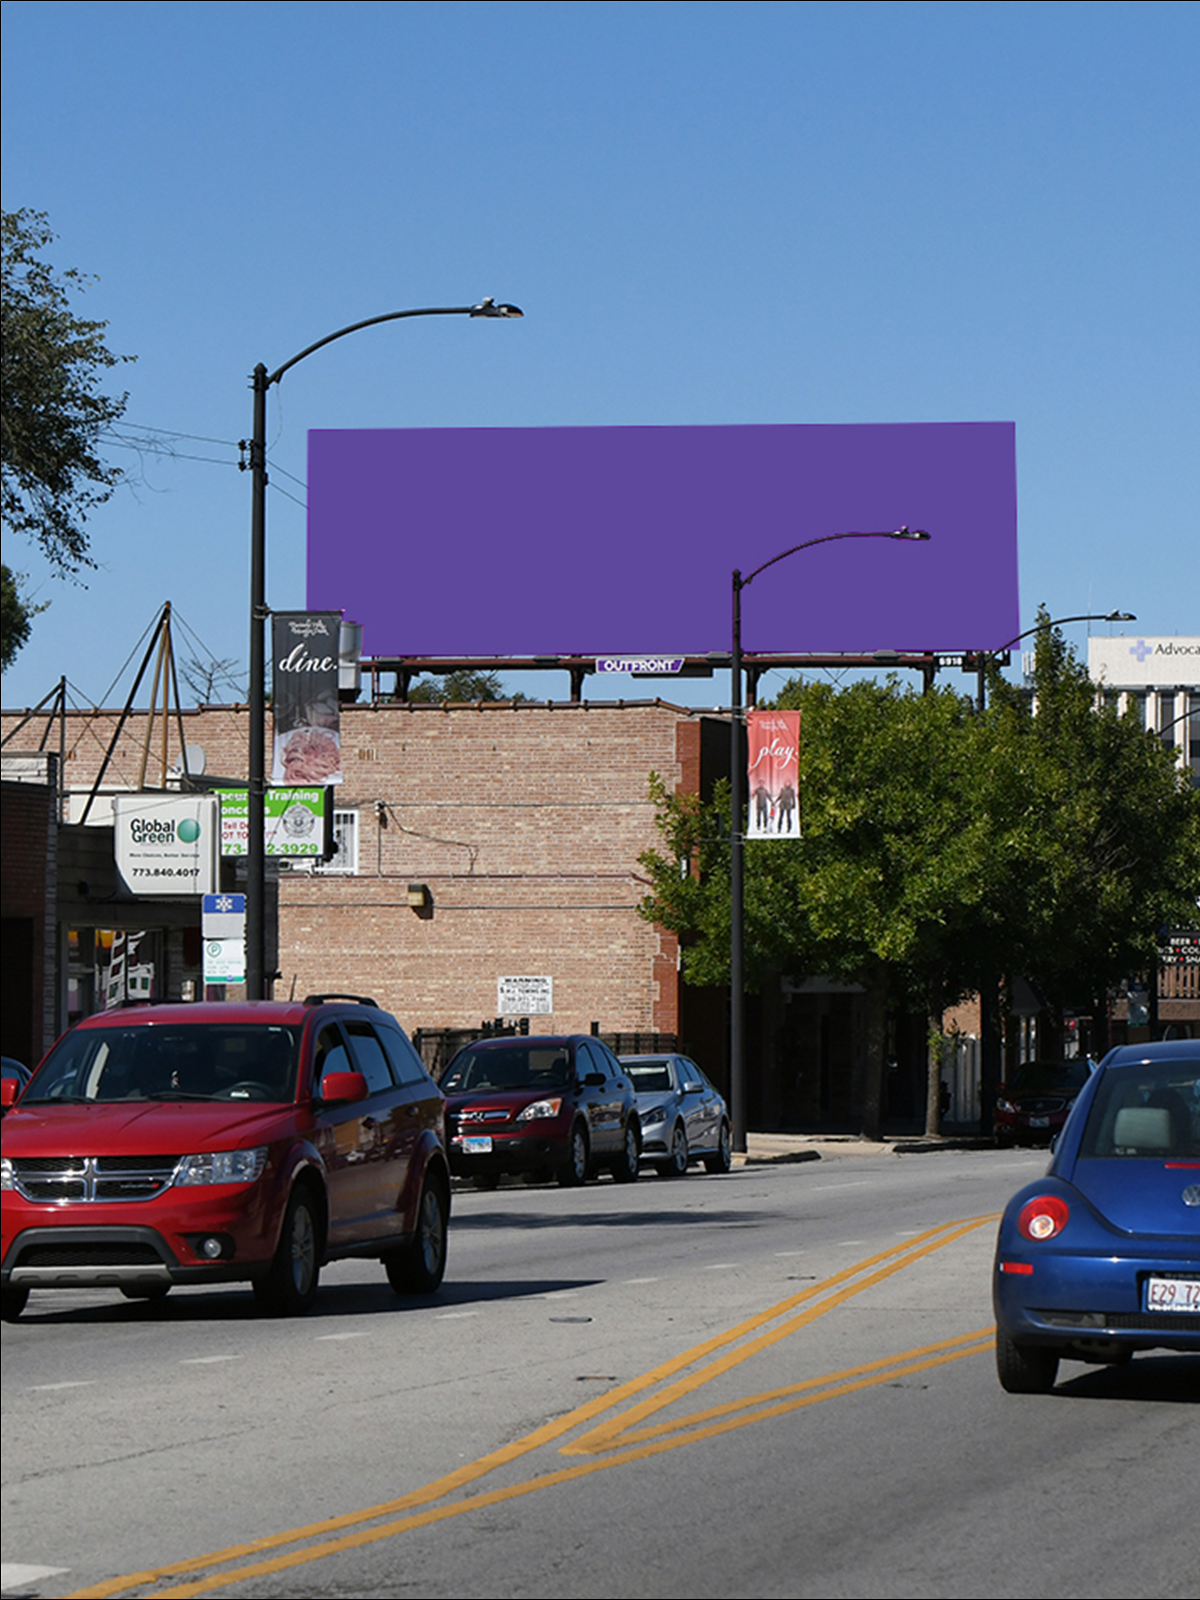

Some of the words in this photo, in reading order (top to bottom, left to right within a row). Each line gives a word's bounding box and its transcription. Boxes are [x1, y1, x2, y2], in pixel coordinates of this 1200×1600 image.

[604, 659, 675, 671] OUTFRONT
[269, 790, 319, 802] Training
[130, 818, 175, 832] Global
[132, 830, 175, 843] Green
[132, 868, 200, 877] 773.840.4017
[1151, 1284, 1177, 1303] E29
